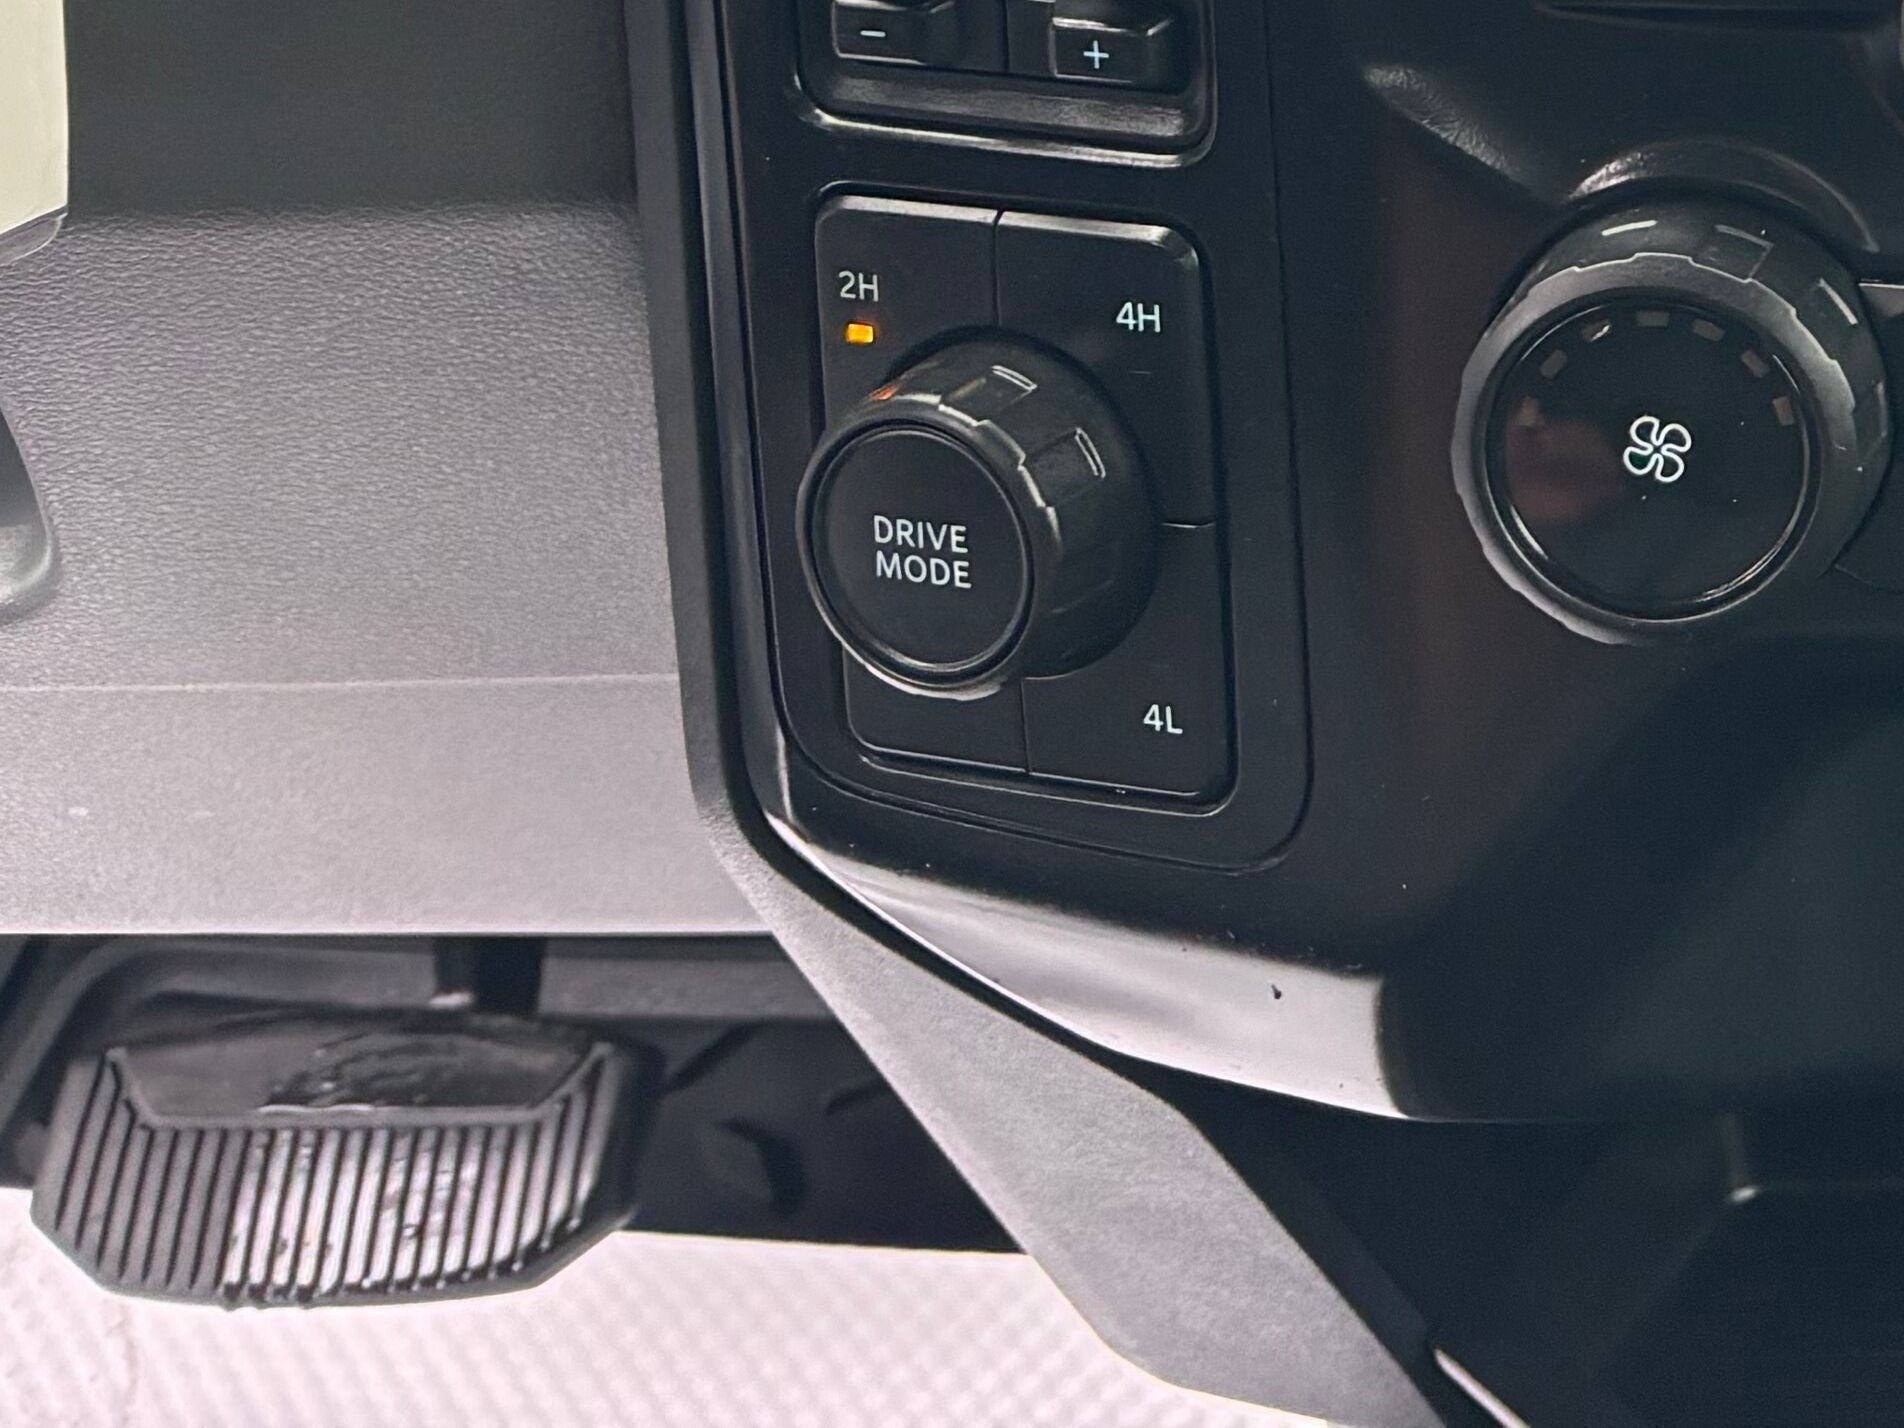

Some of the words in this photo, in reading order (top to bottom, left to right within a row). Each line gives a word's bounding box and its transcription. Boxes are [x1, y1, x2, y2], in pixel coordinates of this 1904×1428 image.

[838, 270, 879, 302] 2H
[1116, 301, 1161, 333] 4H
[873, 515, 969, 554] DRIVE
[876, 549, 972, 589] MODE
[1143, 704, 1183, 735] 4L
